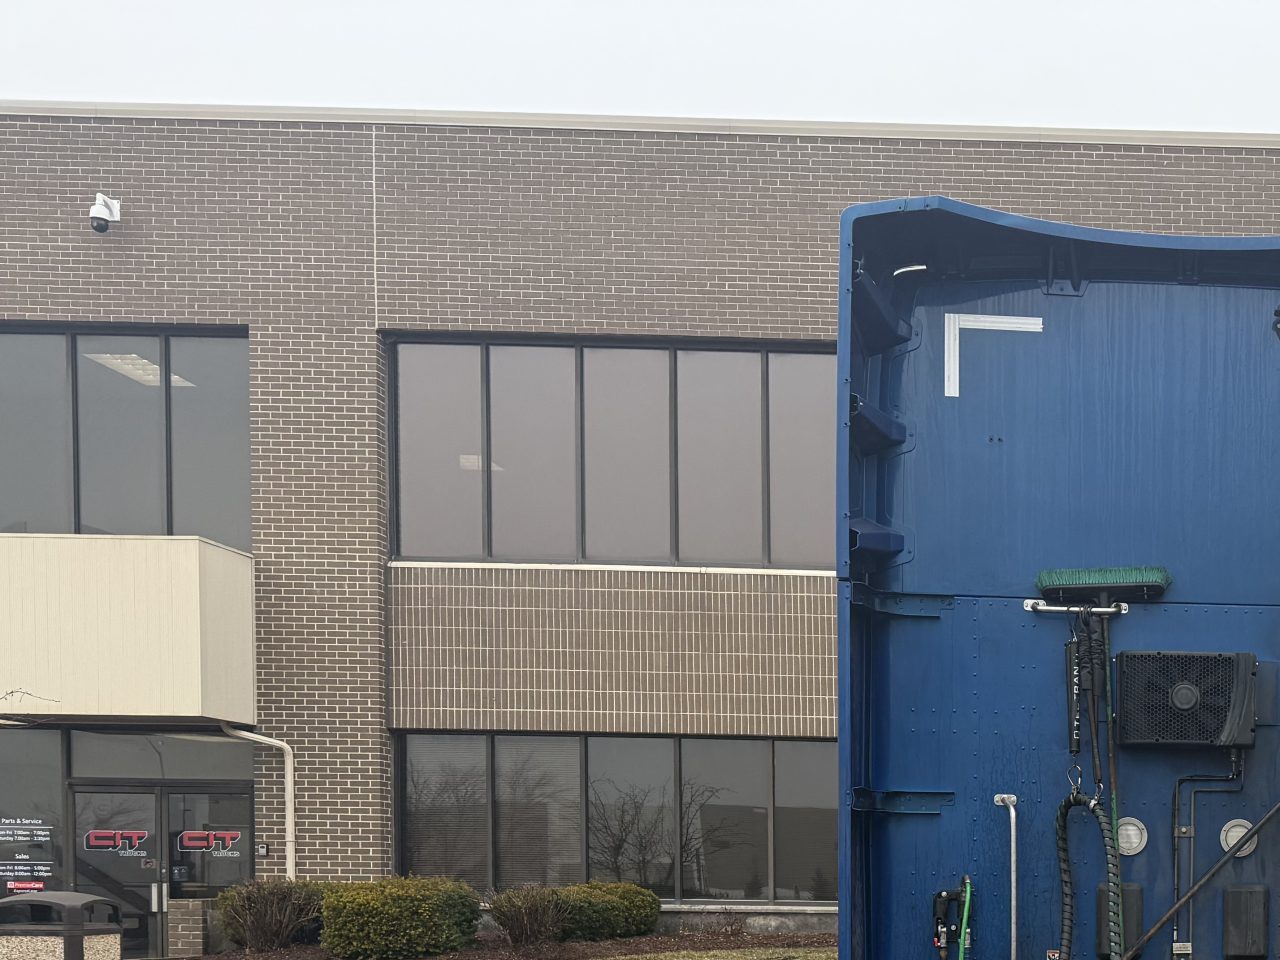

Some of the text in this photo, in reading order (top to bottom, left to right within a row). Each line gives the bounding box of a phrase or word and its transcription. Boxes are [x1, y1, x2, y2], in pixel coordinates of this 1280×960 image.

[84, 830, 148, 850] CIT
[177, 831, 241, 851] CIT
[212, 850, 241, 858] TRUCKS
